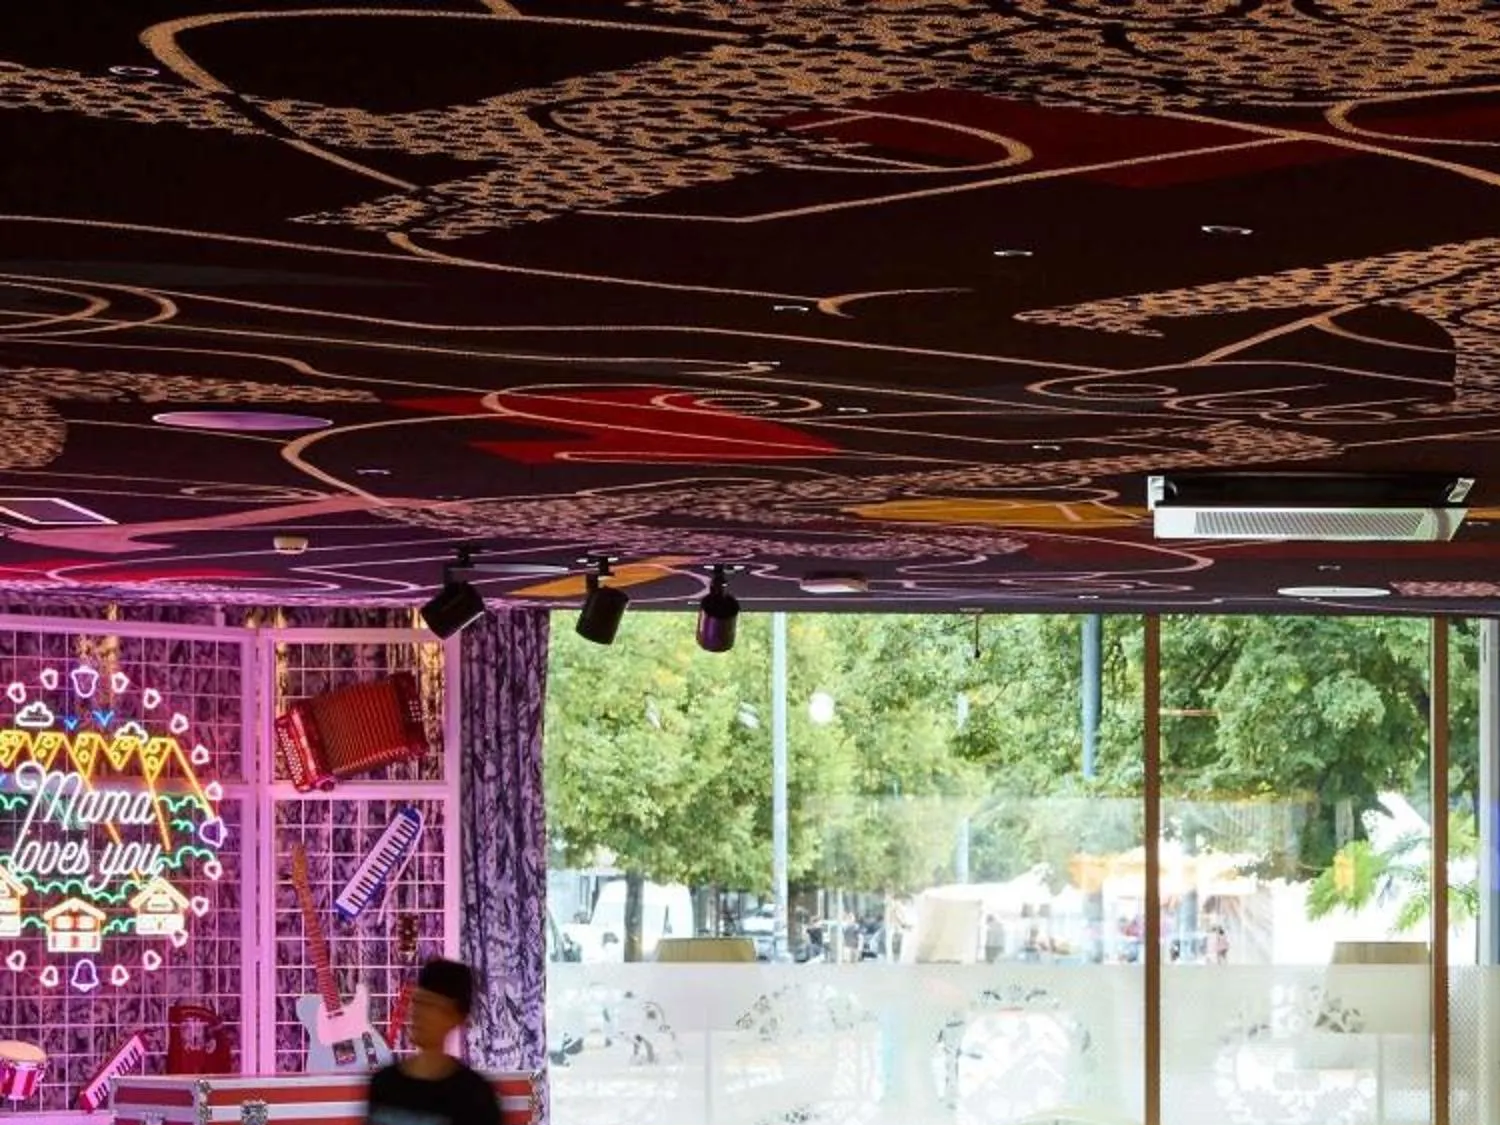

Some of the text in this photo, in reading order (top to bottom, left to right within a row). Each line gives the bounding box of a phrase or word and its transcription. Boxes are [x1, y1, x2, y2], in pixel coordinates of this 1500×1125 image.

[15, 761, 157, 829] Mama
[8, 836, 165, 892] loves you
